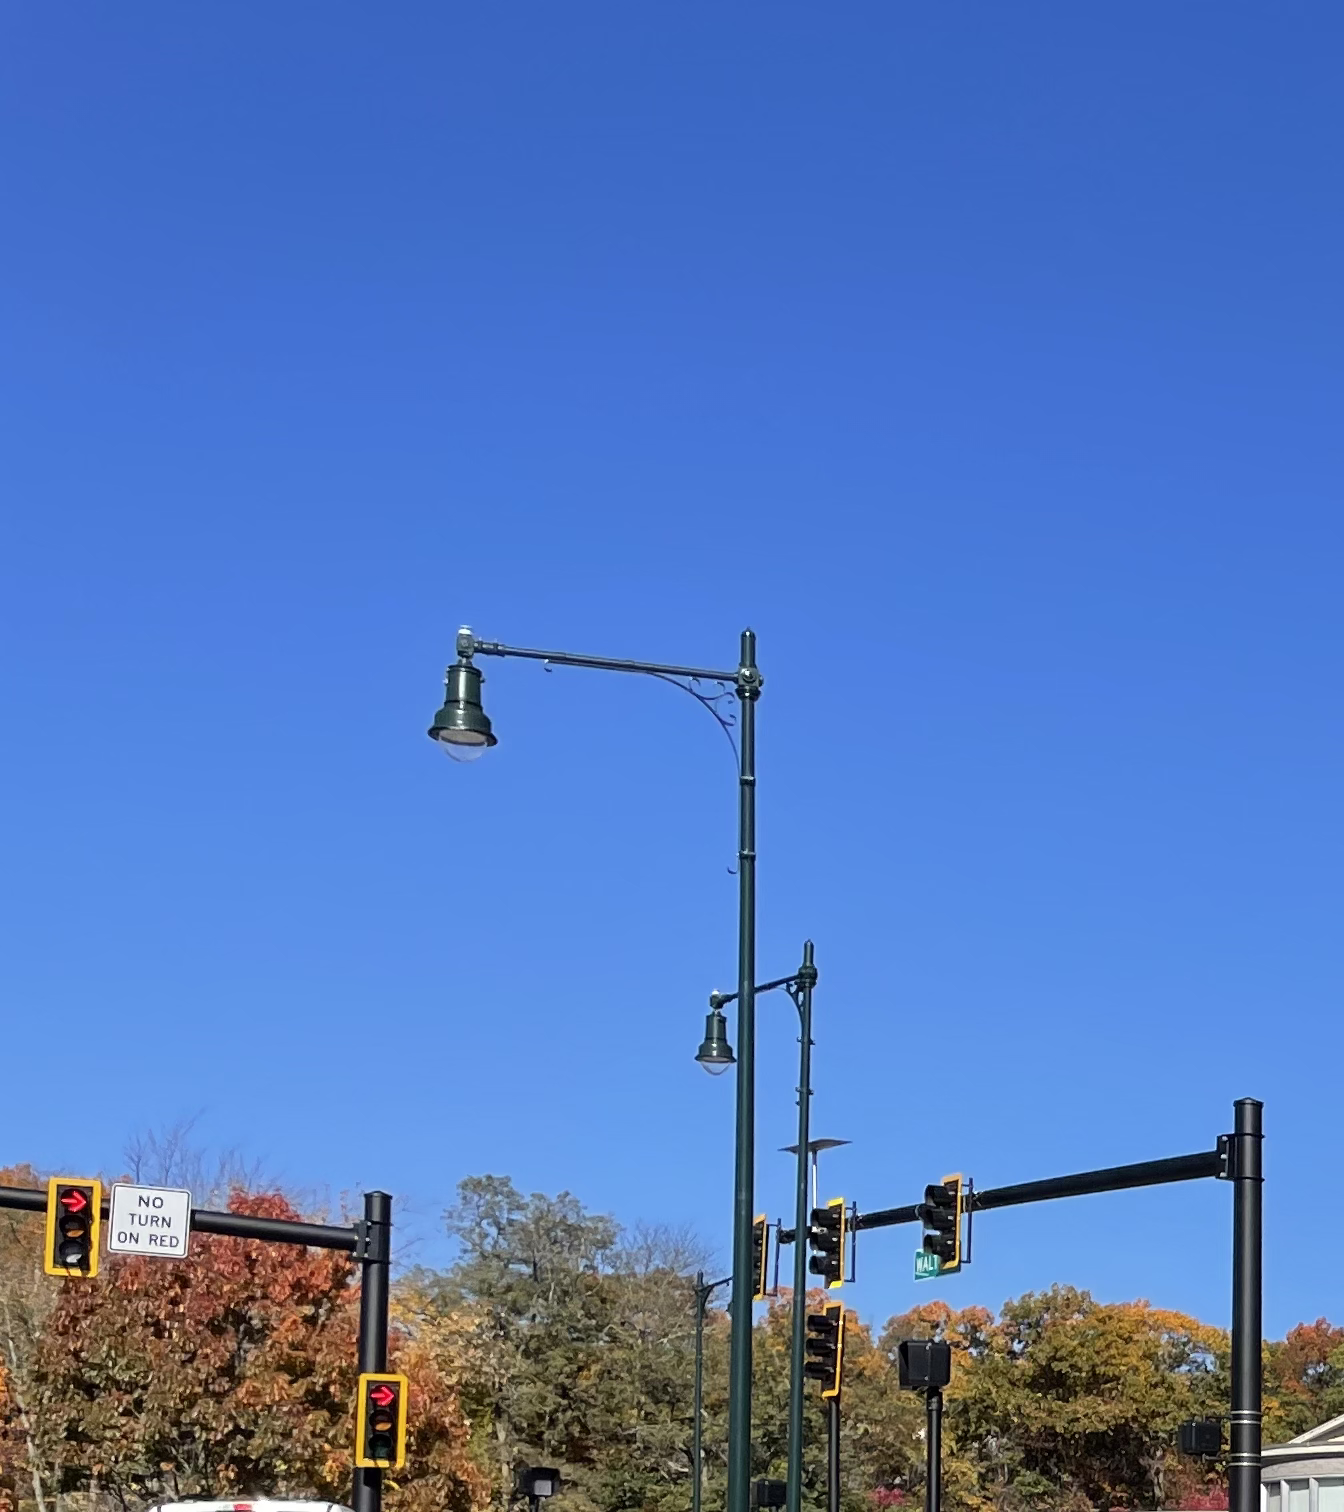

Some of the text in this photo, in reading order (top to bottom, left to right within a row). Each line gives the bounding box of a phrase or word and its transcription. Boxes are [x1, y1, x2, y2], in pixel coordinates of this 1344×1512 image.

[138, 1195, 164, 1208] NO
[129, 1213, 172, 1228] TURN
[117, 1231, 180, 1248] ON RED
[916, 1255, 938, 1272] WALT
